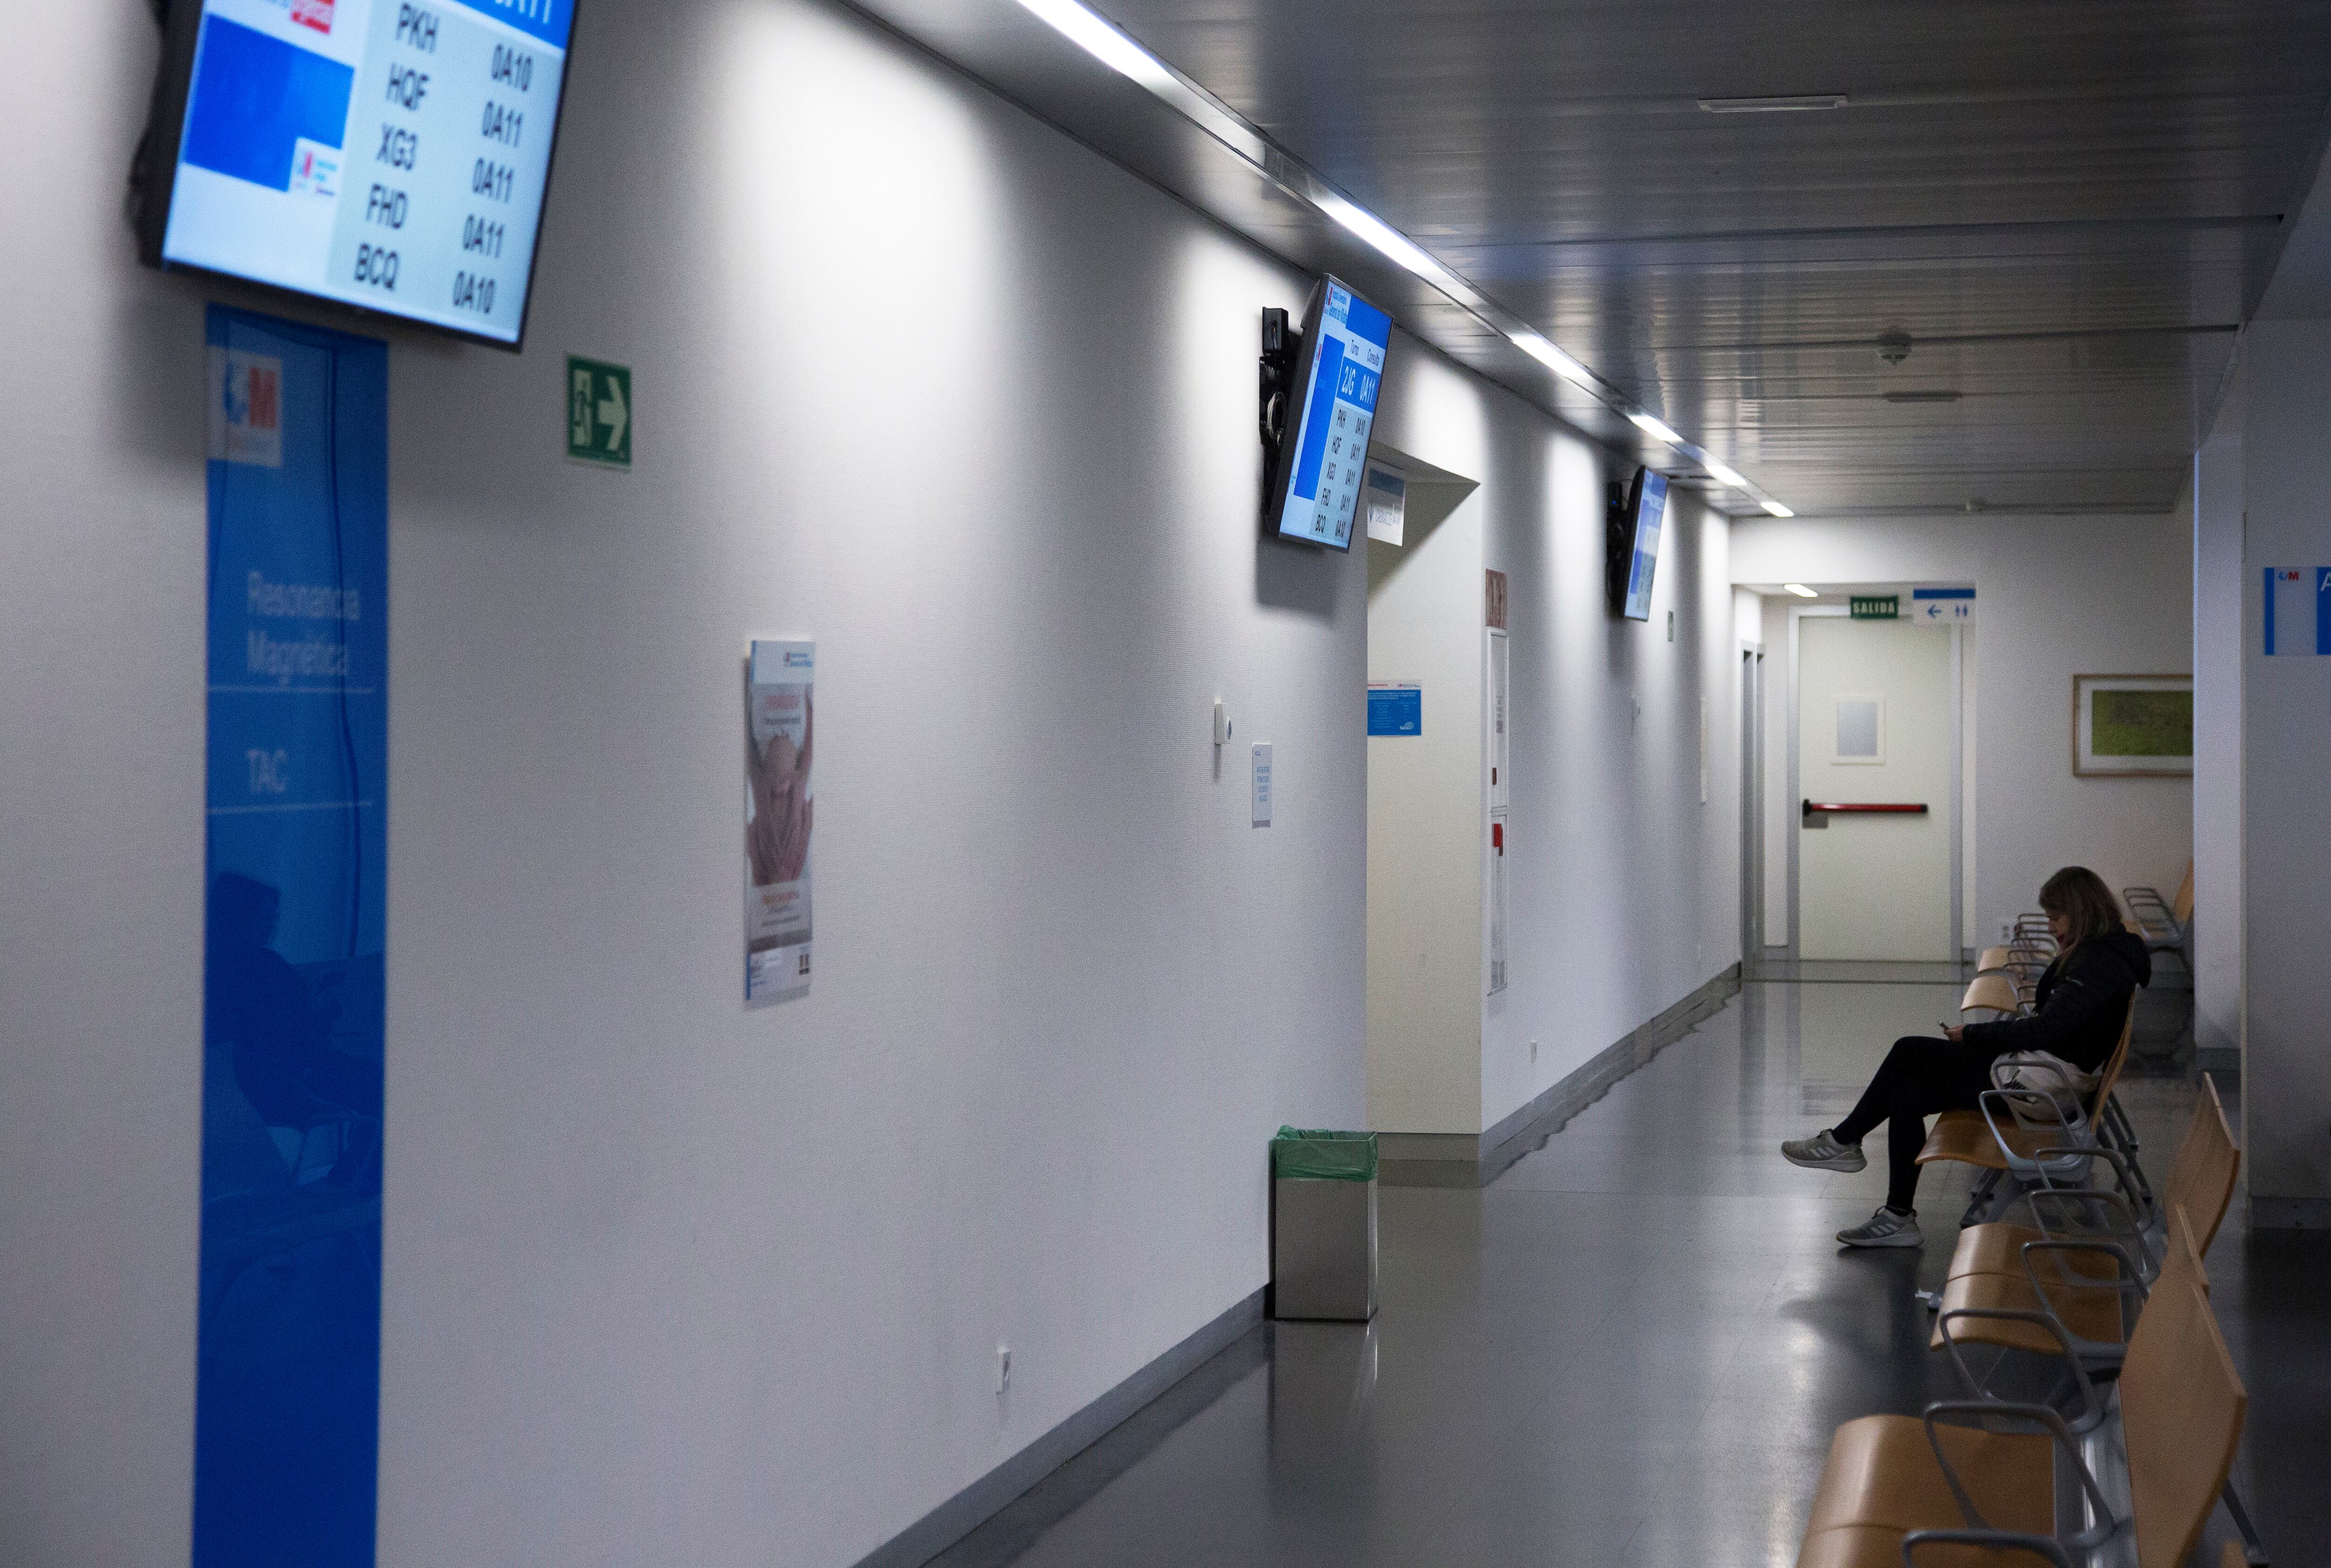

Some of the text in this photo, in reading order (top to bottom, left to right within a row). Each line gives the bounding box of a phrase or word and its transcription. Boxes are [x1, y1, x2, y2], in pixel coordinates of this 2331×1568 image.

[396, 2, 439, 53] PKH
[492, 44, 533, 92] 0A10
[387, 63, 523, 147] HQF 0A11
[376, 123, 513, 203] XG3 0A11
[367, 183, 504, 258] FHD 0A11
[354, 242, 496, 315] BCQ 0A10
[1351, 340, 1380, 366] Turno Consulta
[1341, 365, 1356, 396] 2JG
[1360, 374, 1376, 405] 0A11
[1337, 409, 1365, 436] PKH 0A10
[1331, 435, 1361, 461] HQF 0A11
[1326, 462, 1356, 487] XG3 0A11
[1321, 488, 1351, 513] FHD 0A11
[1315, 514, 1346, 538] BCQ 0A10
[1854, 602, 1895, 614] SALIDA
[247, 749, 287, 793] TAC
